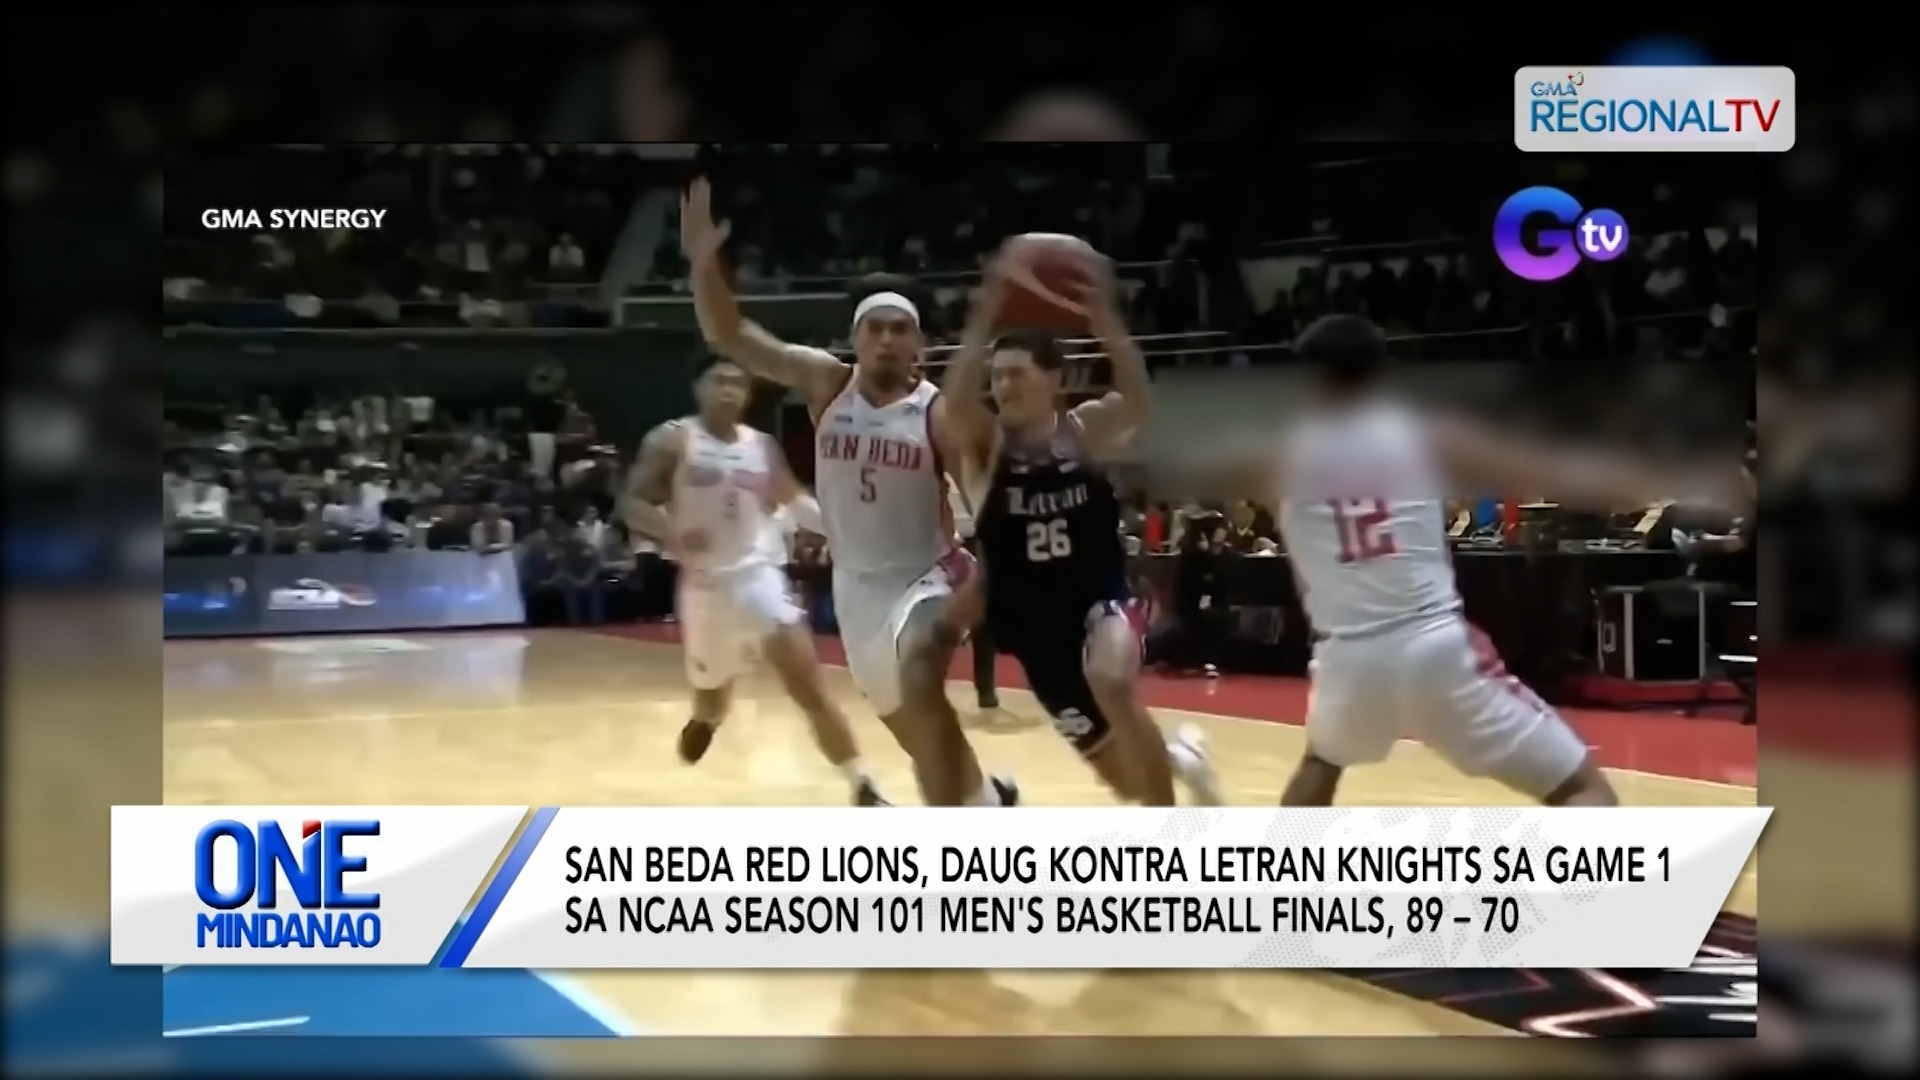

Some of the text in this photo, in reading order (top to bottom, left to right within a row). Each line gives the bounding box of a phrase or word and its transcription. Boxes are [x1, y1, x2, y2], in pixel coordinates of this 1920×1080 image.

[860, 467, 877, 503] 5
[1026, 519, 1072, 561] 26
[1328, 494, 1398, 563] 12
